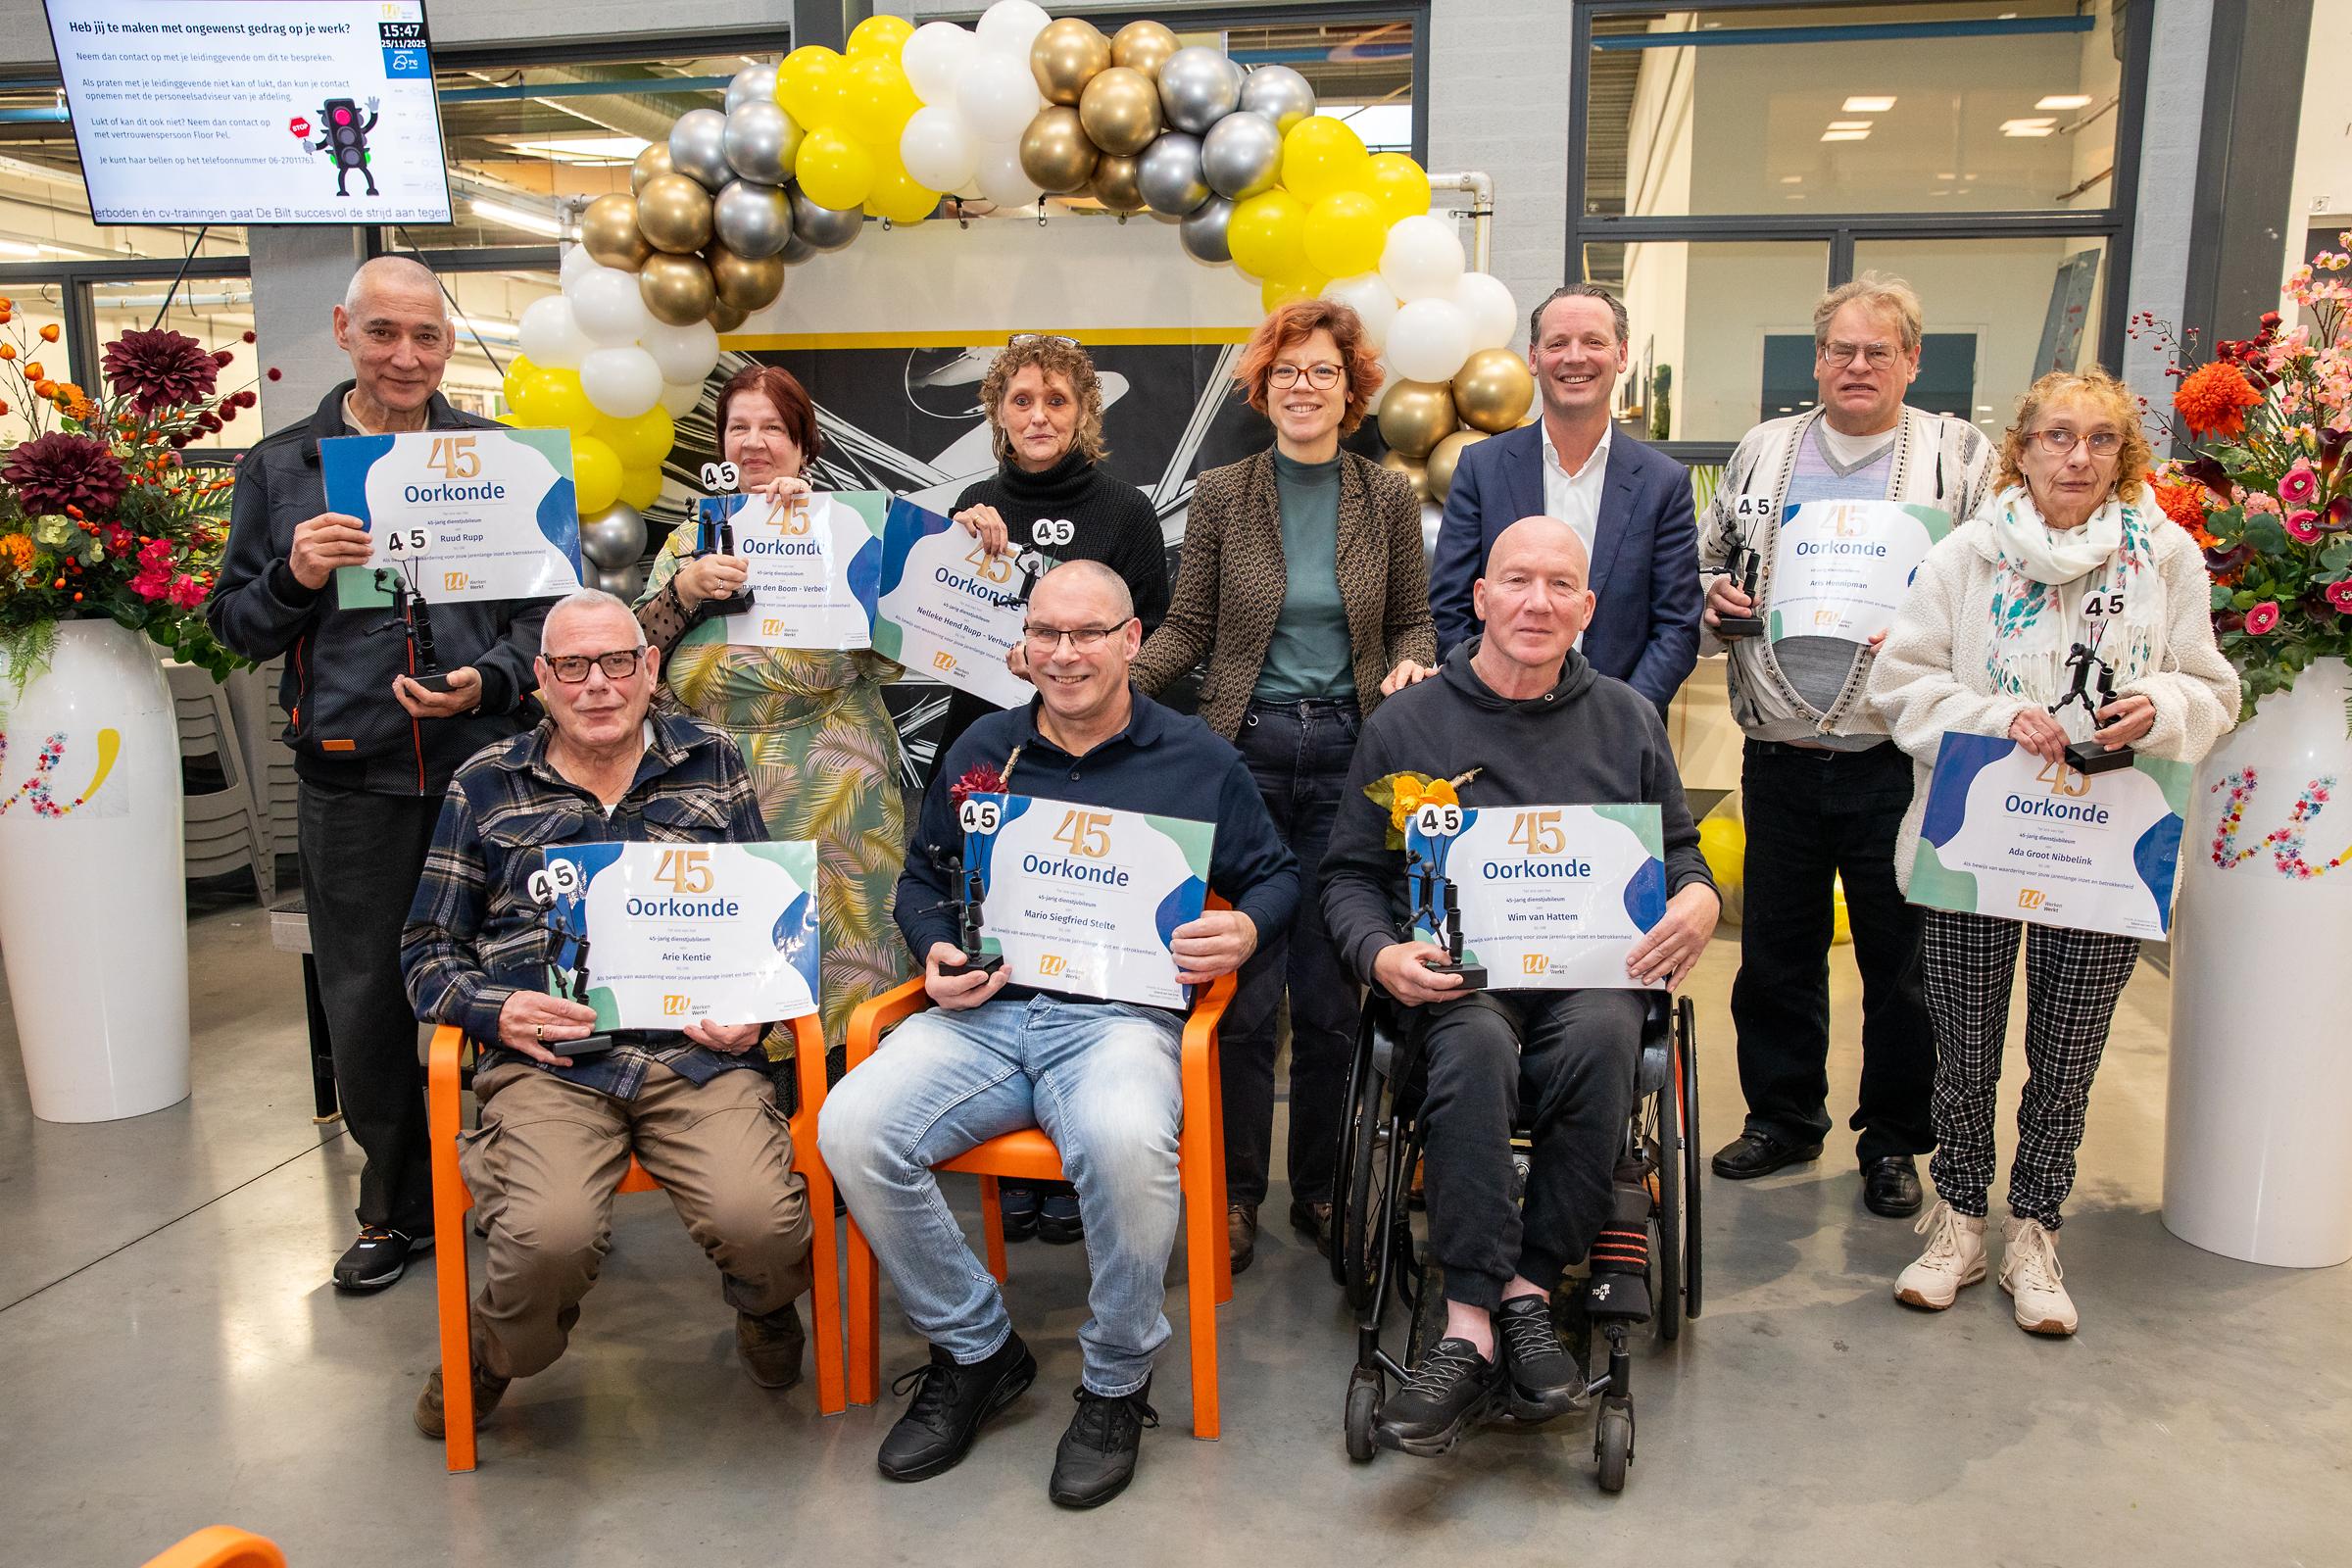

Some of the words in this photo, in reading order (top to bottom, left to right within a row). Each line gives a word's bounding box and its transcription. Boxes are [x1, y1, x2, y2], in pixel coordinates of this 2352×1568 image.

[70, 22, 91, 32] Heb
[94, 21, 104, 35] jij
[107, 23, 119, 32] te
[122, 23, 158, 33] maken
[162, 24, 182, 33] met
[186, 24, 245, 36] ongewenst
[248, 24, 287, 36] gedrag
[289, 25, 302, 35] op
[305, 23, 315, 35] je
[318, 24, 350, 34] werk?
[384, 25, 420, 37] 15:47
[381, 40, 426, 48] 25/11/2025
[76, 52, 99, 61] Neem
[102, 53, 117, 61] dan
[119, 53, 149, 61] contact
[151, 54, 161, 63] op
[181, 54, 188, 63] je
[191, 53, 251, 63] leidinggevende
[290, 54, 334, 63] bespreken.
[97, 80, 123, 88] praten
[142, 80, 149, 89] je
[152, 80, 211, 89] leidinggevende
[258, 80, 276, 88] lukt,
[311, 80, 318, 89] je
[155, 93, 230, 102] personeelsadviseur
[249, 94, 256, 102] je
[259, 93, 293, 102] afdeling.
[292, 123, 308, 132] STOP
[159, 208, 226, 220] cv-trainingen
[230, 209, 254, 220] gaat
[256, 208, 271, 218] De
[274, 208, 291, 218] Bilt
[294, 208, 346, 218] succesvol
[350, 208, 363, 218] de
[367, 208, 392, 219] strijd
[396, 210, 415, 218] aan
[418, 208, 448, 219] tegen
[427, 436, 482, 479] 45
[405, 482, 505, 503] Oorkonde
[1739, 499, 1769, 515] 45
[463, 533, 483, 542] Rupp
[1037, 523, 1069, 540] 45
[1797, 540, 1886, 557] Oorkonde
[2085, 594, 2124, 616] 45
[917, 607, 943, 622] Nelleke
[944, 618, 962, 629] Hend
[963, 625, 981, 637] Rupp
[964, 806, 995, 828] 45
[2005, 794, 2109, 824] Oorkonde
[1422, 809, 1459, 830] 45
[1053, 810, 1113, 858] 45
[1508, 810, 1566, 855] 45
[2009, 847, 2024, 856] Ada
[2026, 850, 2050, 860] Groot
[2052, 853, 2092, 865] Nibbelink
[653, 849, 714, 893] 45
[1023, 854, 1129, 887] Oorkonde
[1483, 859, 1591, 879] Oorkonde
[626, 897, 739, 917] Oorkonde
[1025, 910, 1047, 920] Mario
[1049, 913, 1088, 926] Siegfried
[662, 952, 680, 961] Arie
[683, 953, 711, 961] Kentie
